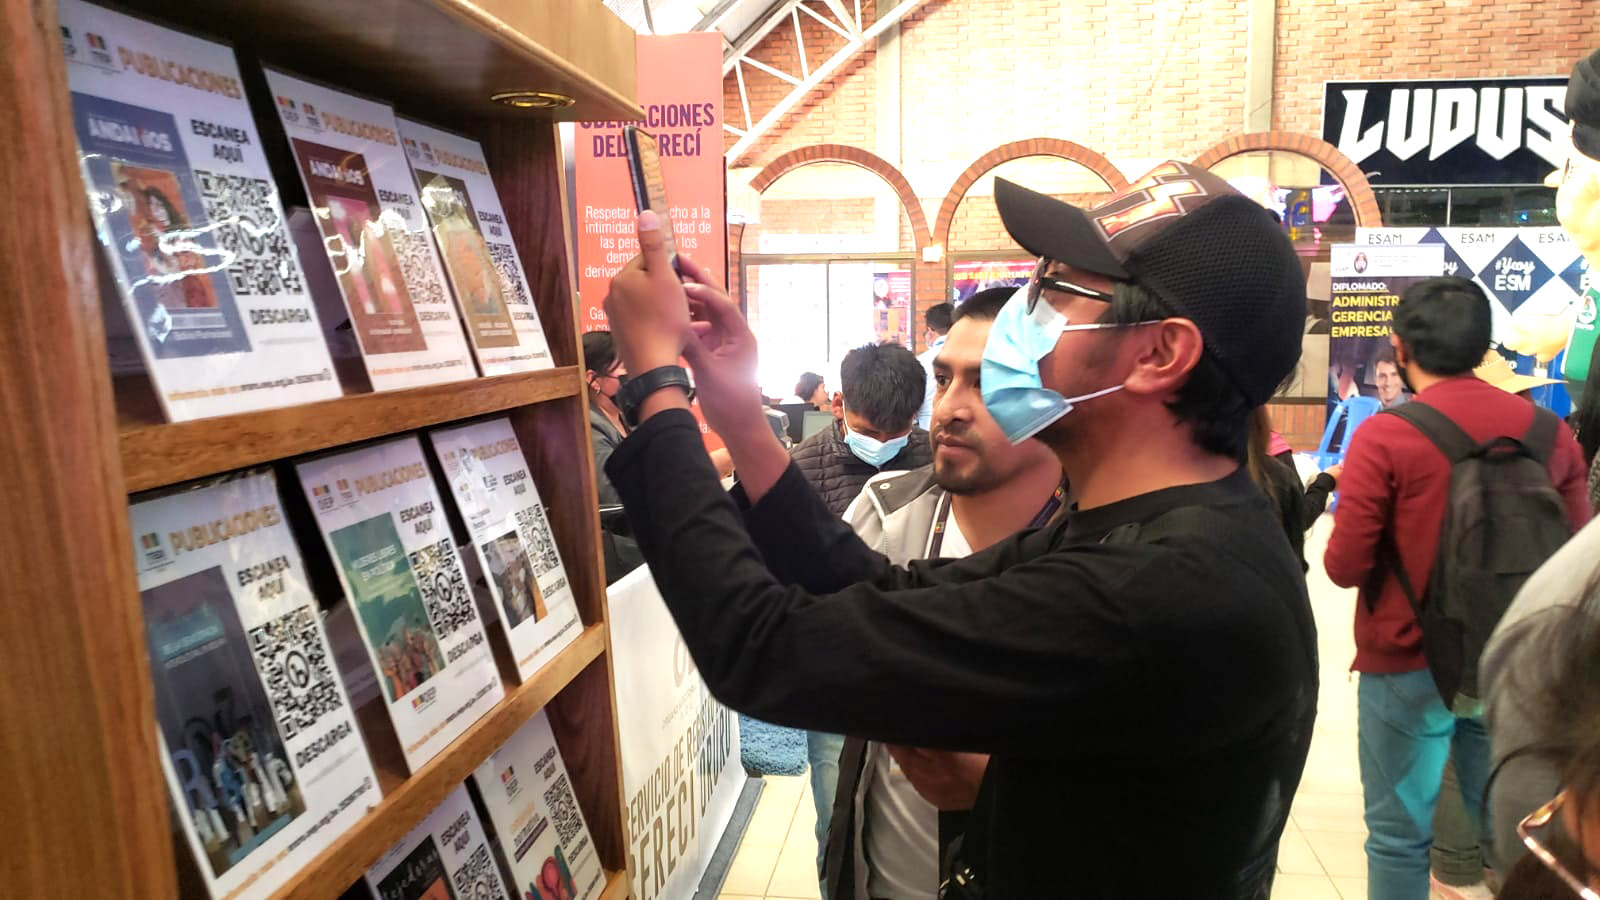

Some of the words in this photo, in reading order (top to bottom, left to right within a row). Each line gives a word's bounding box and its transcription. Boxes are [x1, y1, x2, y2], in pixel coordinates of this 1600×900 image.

[189, 119, 250, 146] ESCANEA
[1338, 86, 1568, 169] LUDUS
[653, 127, 703, 157] RECÍ
[212, 143, 243, 164] AQUÍ
[585, 205, 630, 223] Respetar
[691, 208, 698, 219] a
[701, 205, 711, 219] la
[585, 221, 635, 235] intimidad
[698, 221, 712, 234] de
[1461, 233, 1495, 244] ESAM
[1539, 233, 1570, 244] ESA
[600, 235, 615, 250] las
[618, 237, 641, 250] pers
[681, 235, 698, 249] los
[1368, 234, 1403, 245] ESAM
[1332, 282, 1387, 291] DIPLOMADO:
[1332, 295, 1400, 308] ADMINISTR
[249, 308, 313, 325] DESCARGA
[1331, 325, 1393, 338] EMPRESA
[400, 500, 436, 524] ESCANEA
[168, 503, 282, 557] PUBLICACIONES
[237, 555, 291, 588] ESCANEA
[447, 631, 484, 665] DESCARGA
[295, 719, 353, 770] DESCARGA
[673, 735, 685, 787] DE
[700, 704, 731, 818] ORURO
[439, 809, 472, 848] ESCANEA
